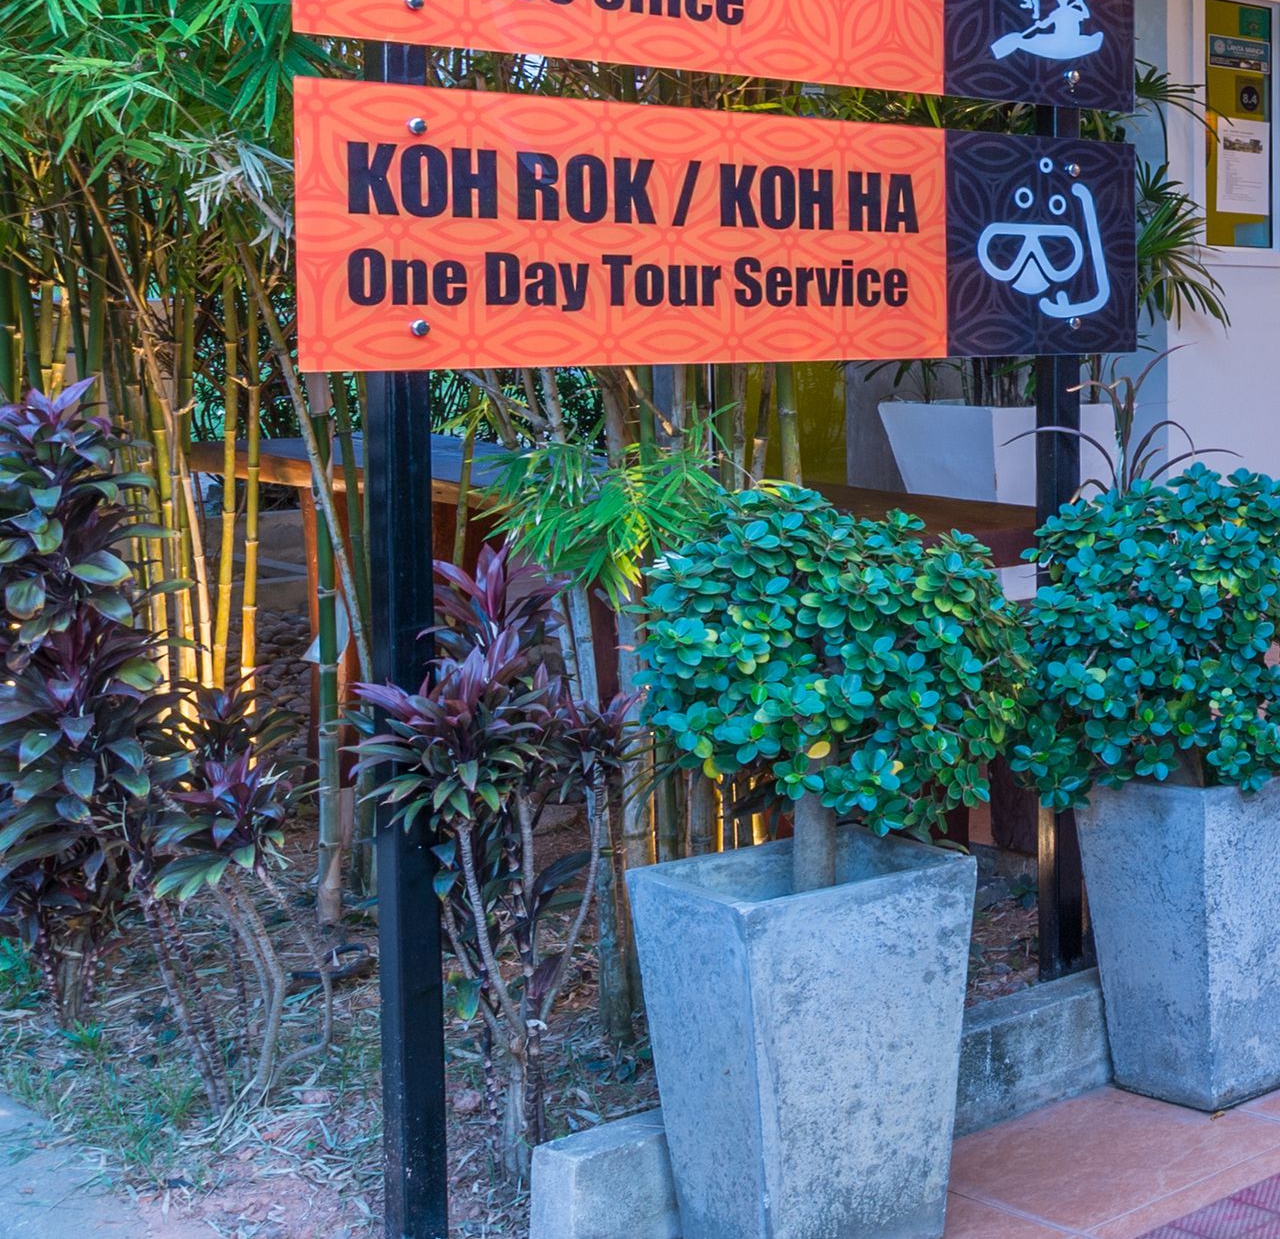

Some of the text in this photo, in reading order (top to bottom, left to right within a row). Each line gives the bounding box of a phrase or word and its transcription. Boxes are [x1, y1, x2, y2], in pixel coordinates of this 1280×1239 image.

[1242, 93, 1258, 105] 8.4
[347, 141, 920, 233] KOH ROK / KOH HA
[347, 248, 908, 311] One Day Tour Service
